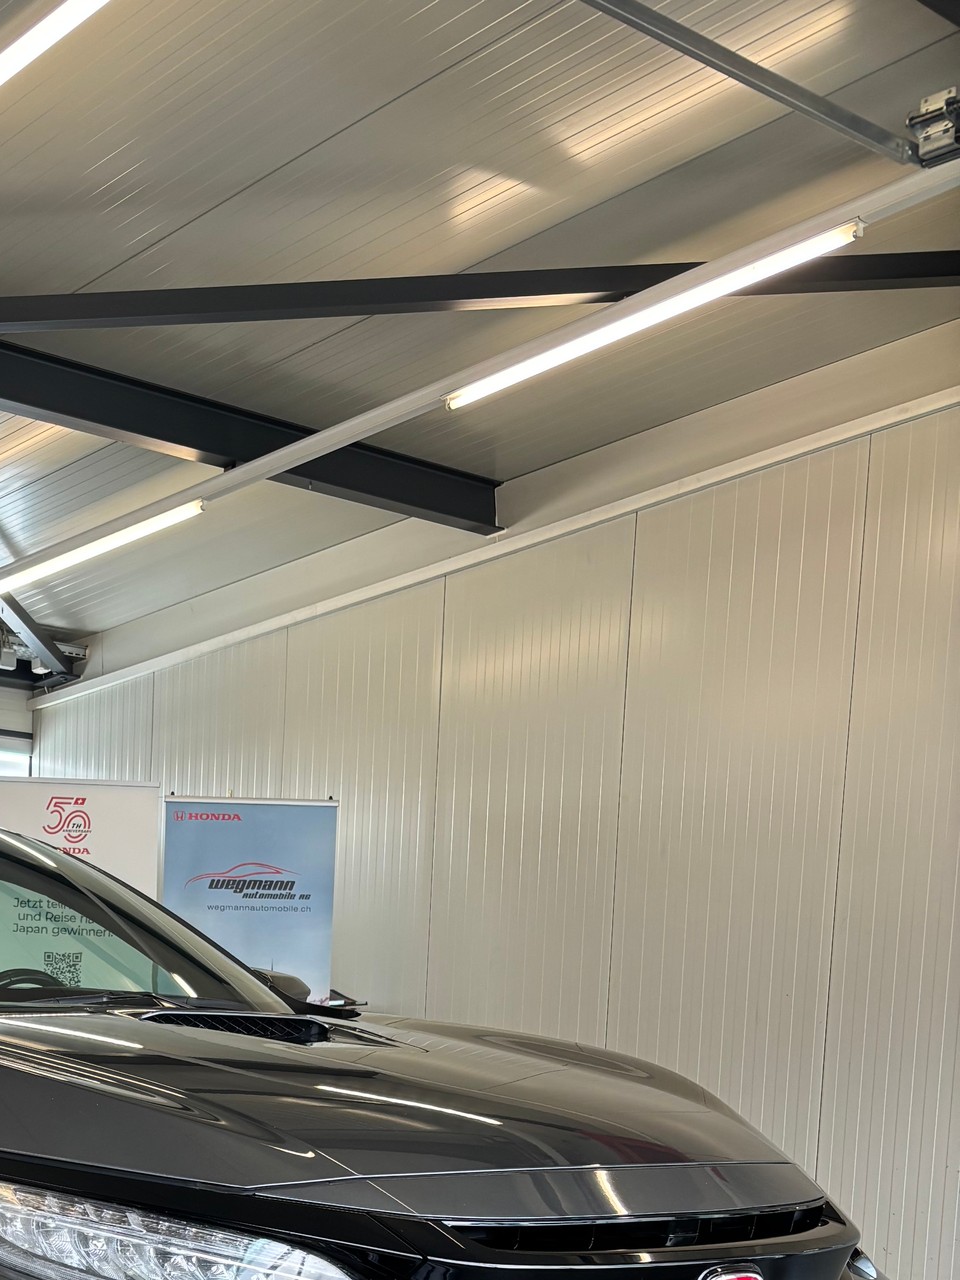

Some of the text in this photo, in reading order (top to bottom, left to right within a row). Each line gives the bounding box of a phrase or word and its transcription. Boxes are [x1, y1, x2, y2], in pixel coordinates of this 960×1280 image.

[187, 813, 242, 821] HONDA
[207, 878, 296, 894] wegmann
[242, 891, 296, 900] automobile
[13, 897, 43, 909] Jetzt
[207, 904, 312, 913] wegmannautomobile.ch
[17, 911, 41, 922] und
[45, 911, 76, 923] Reise
[12, 922, 114, 937] Japan gewinnen.
